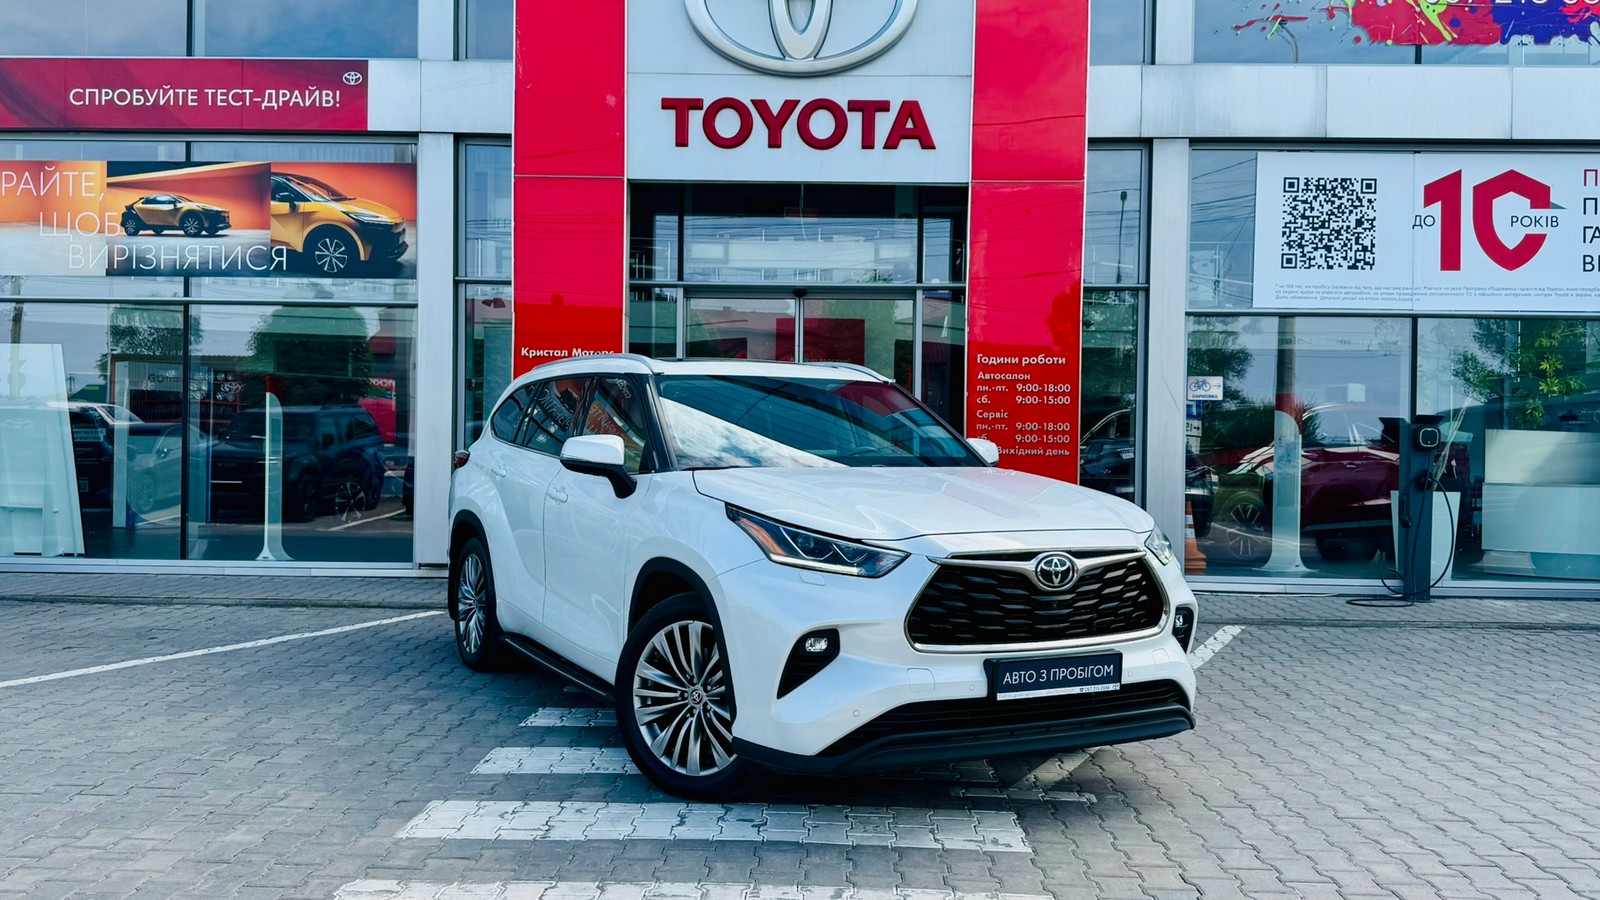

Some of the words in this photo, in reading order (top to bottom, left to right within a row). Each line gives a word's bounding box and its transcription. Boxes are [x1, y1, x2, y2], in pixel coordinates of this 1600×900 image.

[69, 85, 198, 107] СПРОБУЙТЕ
[205, 86, 341, 110] ТЕСТ-ДРАЙВ!
[661, 97, 936, 151] TOYOTA
[2, 166, 105, 201] РАЙТЕ,
[39, 211, 121, 242] ЩОБ
[1412, 215, 1435, 229] ДО
[1510, 215, 1560, 228] РОКІВ
[68, 245, 287, 271] ВИРІЗНЯТИСЯ
[520, 346, 568, 359] Кристал
[977, 354, 1018, 364] Години
[1022, 354, 1066, 366] роботи
[977, 371, 1031, 380] Автосалон
[1016, 383, 1071, 392] 9:00-18:00
[976, 395, 991, 404] сб.
[1015, 395, 1071, 404] 9:00-15:00
[976, 410, 1009, 419] Сервіс
[1015, 422, 1070, 431] 9:00-18:00
[1015, 435, 1070, 443] 9:00-15:00
[1046, 448, 1070, 456] день
[1003, 670, 1036, 685] АВТО
[1039, 669, 1047, 682] З
[1050, 664, 1114, 682] ПРОБІГОМ
